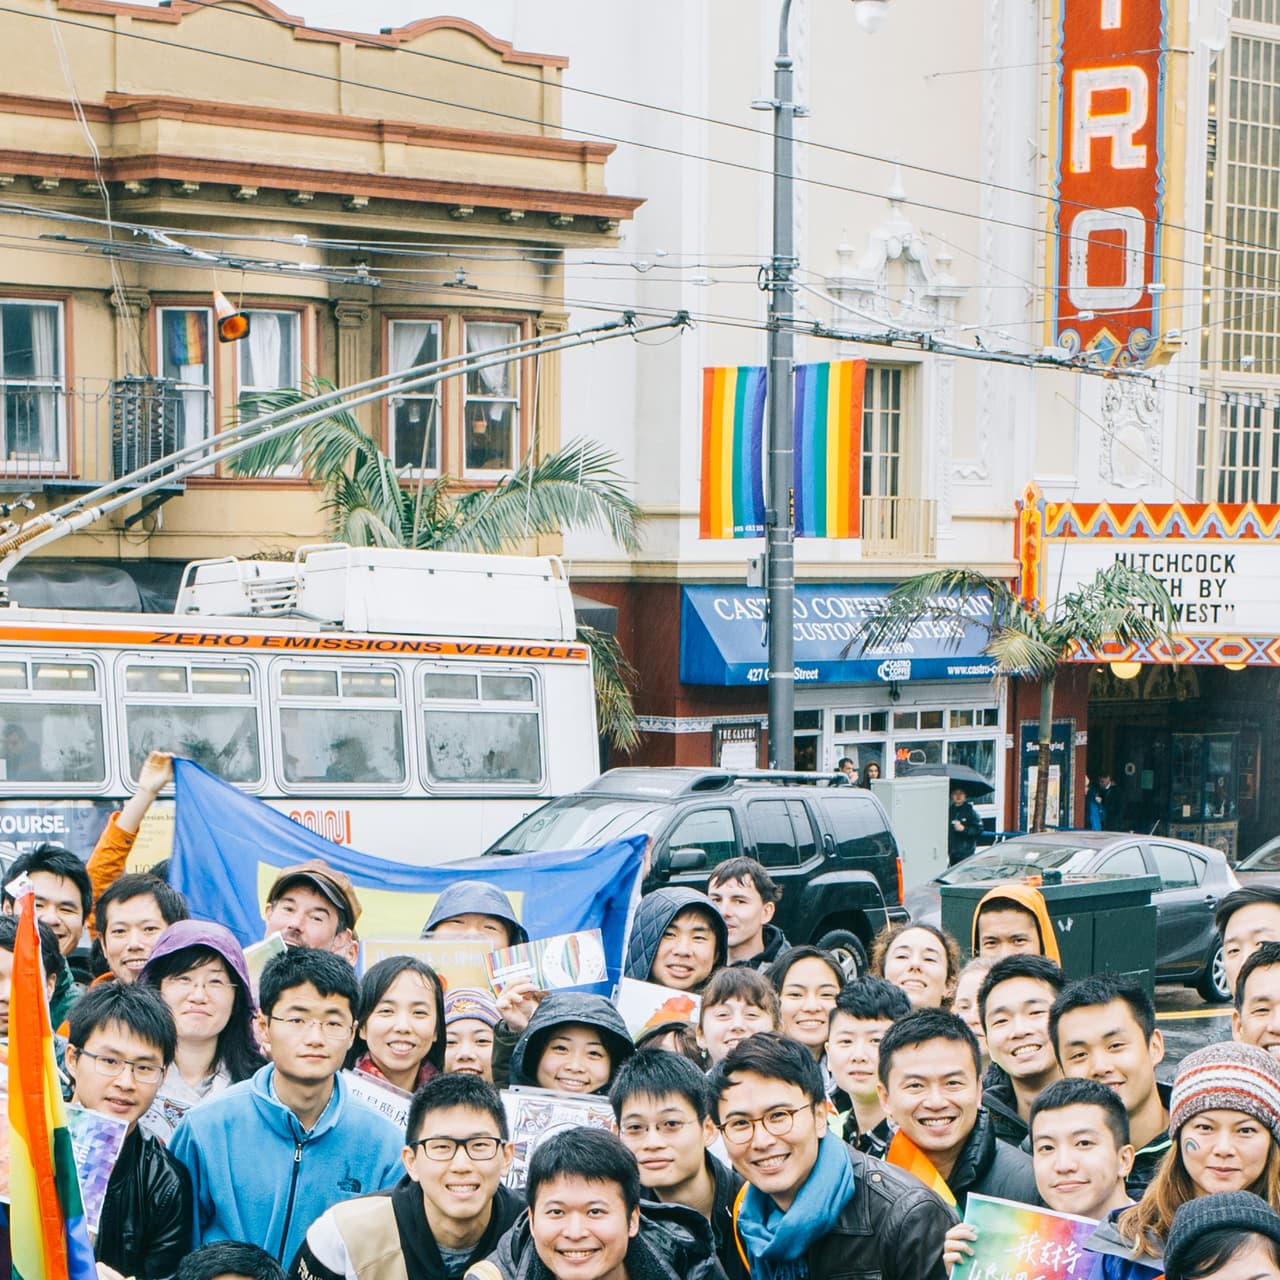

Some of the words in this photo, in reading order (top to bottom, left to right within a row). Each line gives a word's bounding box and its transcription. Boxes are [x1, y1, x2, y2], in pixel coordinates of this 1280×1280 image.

[1068, 0, 1148, 310] RO
[1200, 579, 1226, 598] BY
[714, 597, 809, 621] CASTO
[150, 631, 248, 646] ZERO
[259, 635, 442, 653] EMISSIONS
[454, 642, 587, 660] VEHICLE
[746, 668, 762, 681] 427
[794, 667, 819, 680] Street
